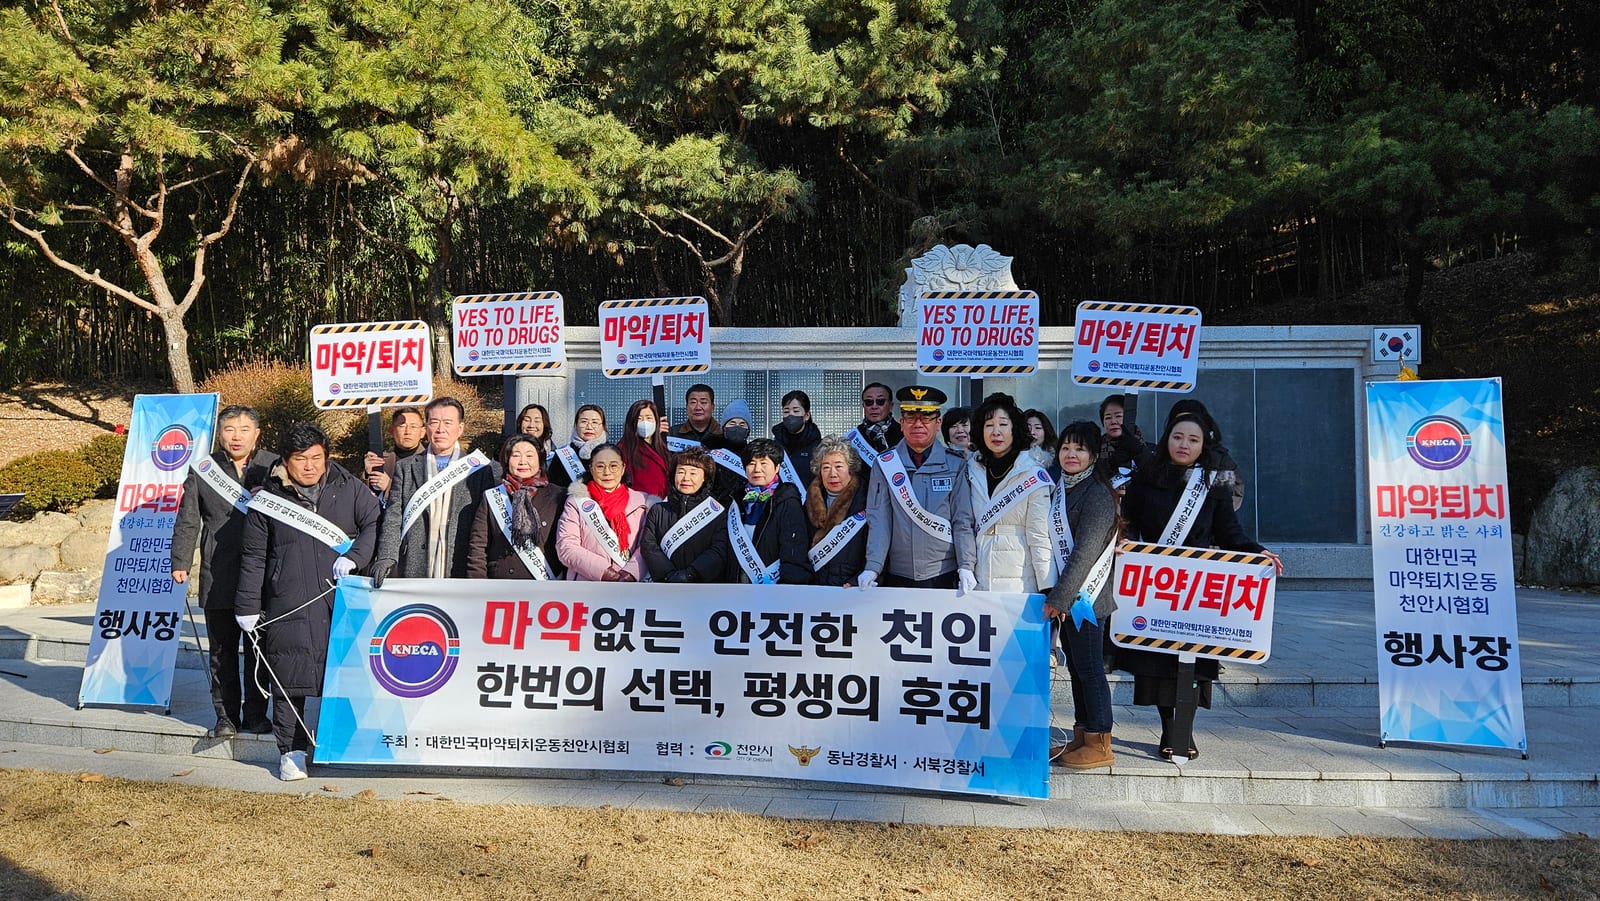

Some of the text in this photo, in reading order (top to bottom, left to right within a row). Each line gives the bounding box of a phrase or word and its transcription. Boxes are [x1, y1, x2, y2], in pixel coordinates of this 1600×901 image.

[458, 305, 559, 327] YES TO LIFE,
[923, 304, 1035, 326] YES TO LIFE,
[457, 325, 560, 348] NO TO DRUGS
[604, 312, 705, 348] 마약/퇴치
[921, 326, 1035, 346] NO TO DRUGS
[1078, 319, 1197, 359] 마약/퇴치
[316, 338, 425, 376] 마약/퇴치
[1421, 438, 1456, 446] KNECA
[119, 483, 185, 513] 마약퇴
[1376, 484, 1505, 521] 마약퇴치
[1379, 524, 1503, 539] 건강하고 밝은 사회
[114, 557, 172, 574] 마약퇴치운
[1405, 547, 1477, 567] 대한민국
[116, 578, 174, 595] 천안시협회
[1119, 563, 1271, 621] 마약/퇴치
[1390, 571, 1498, 592] 마약퇴치운동
[1399, 595, 1490, 616] 천안시협회
[99, 610, 179, 641] 행사장
[482, 600, 997, 667] 마약없는 안전한 천안
[1150, 618, 1253, 639] 대한민국마약퇴치운동천안시협회
[391, 644, 439, 656] KNECA
[1383, 631, 1512, 672] 행사장
[476, 661, 991, 730] 한번의 선택, 평생의 후회
[381, 734, 409, 749] 주최
[425, 735, 631, 755] 대한민국마약퇴치운동천안시협회
[656, 741, 683, 757] 협력
[736, 744, 773, 757] 천안시
[826, 749, 897, 769] 동남경찰서
[913, 756, 985, 776] 서북경찰서
